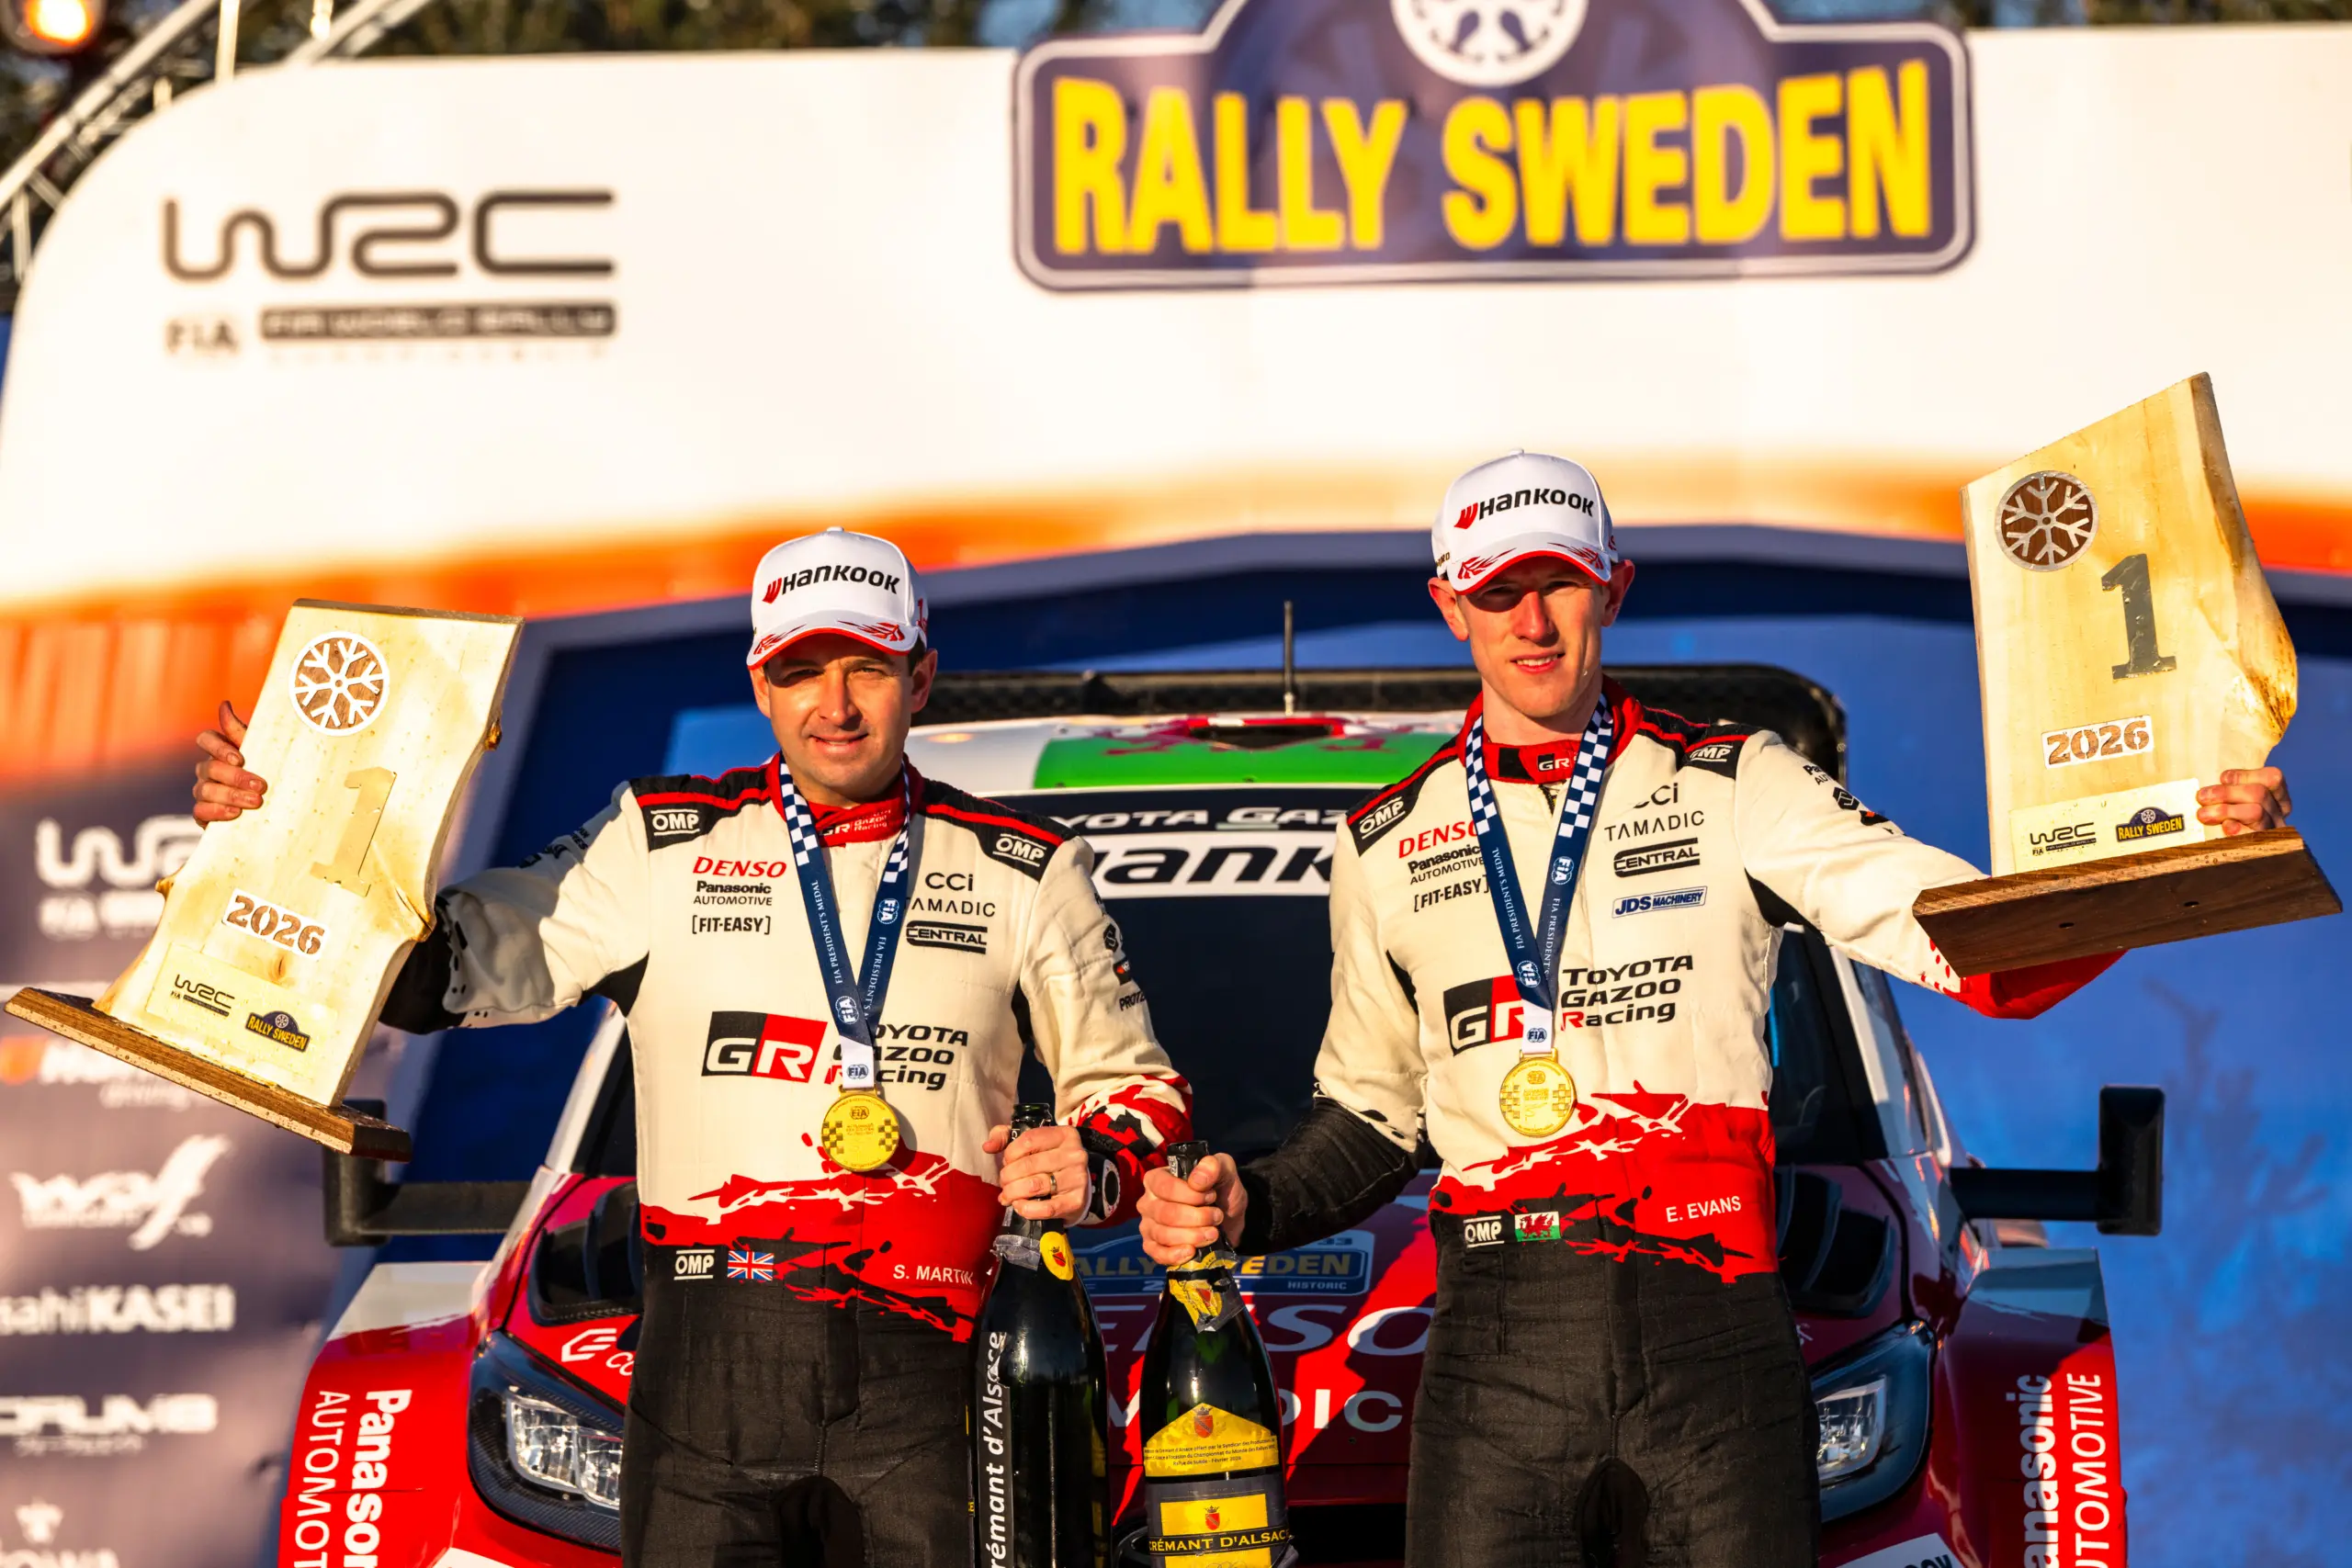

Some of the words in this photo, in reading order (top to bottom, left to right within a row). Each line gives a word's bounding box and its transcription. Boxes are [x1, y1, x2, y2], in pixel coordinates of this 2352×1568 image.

[1051, 75, 1407, 254] RALLY
[1441, 59, 1930, 251] SWEDEN
[165, 192, 613, 281] WRC
[2101, 553, 2177, 680] 1
[2047, 720, 2149, 764] 2026
[652, 814, 699, 830] OMP
[1360, 801, 1404, 834] OMP
[1604, 810, 1705, 841] TAMADIC
[2118, 825, 2144, 840] RALLY
[2146, 817, 2183, 835] SWEDEN
[310, 766, 398, 898] 1
[2030, 822, 2096, 845] WRC
[996, 838, 1046, 861] OMP
[1408, 844, 1481, 874] Panasonic
[1492, 847, 1505, 877] MEDAL
[1613, 847, 1700, 872] CENTRAL
[693, 856, 787, 878] DENSO
[694, 896, 773, 906] AUTOMOTIVE
[696, 881, 772, 894] Panasonic
[811, 880, 824, 911] MEDAL
[1551, 897, 1560, 913] FIA
[1615, 897, 1651, 915] JDS
[1652, 892, 1703, 907] MACHINERY
[227, 895, 325, 954] 2026
[906, 928, 988, 945] CENTRAL
[876, 936, 887, 951] FIA
[1515, 933, 1524, 949] FIA
[833, 968, 843, 985] FIA
[1562, 955, 1693, 987] TOYOTA
[174, 974, 235, 1009] WRC
[1561, 978, 1680, 1009] GAZOO
[1560, 1002, 1676, 1031] Racing
[247, 1016, 274, 1035] RALLY
[272, 1029, 308, 1050] SWEDEN
[706, 1037, 814, 1079] GR
[1666, 1207, 1684, 1223] E.
[1688, 1196, 1742, 1219] EVANS
[1464, 1221, 1502, 1242] OMP
[674, 1255, 714, 1274] OMP
[893, 1265, 910, 1280] S.
[1288, 1280, 1347, 1291] HISTORIC
[2006, 1375, 2060, 1568] anasonic
[985, 1462, 1007, 1568] rémant
